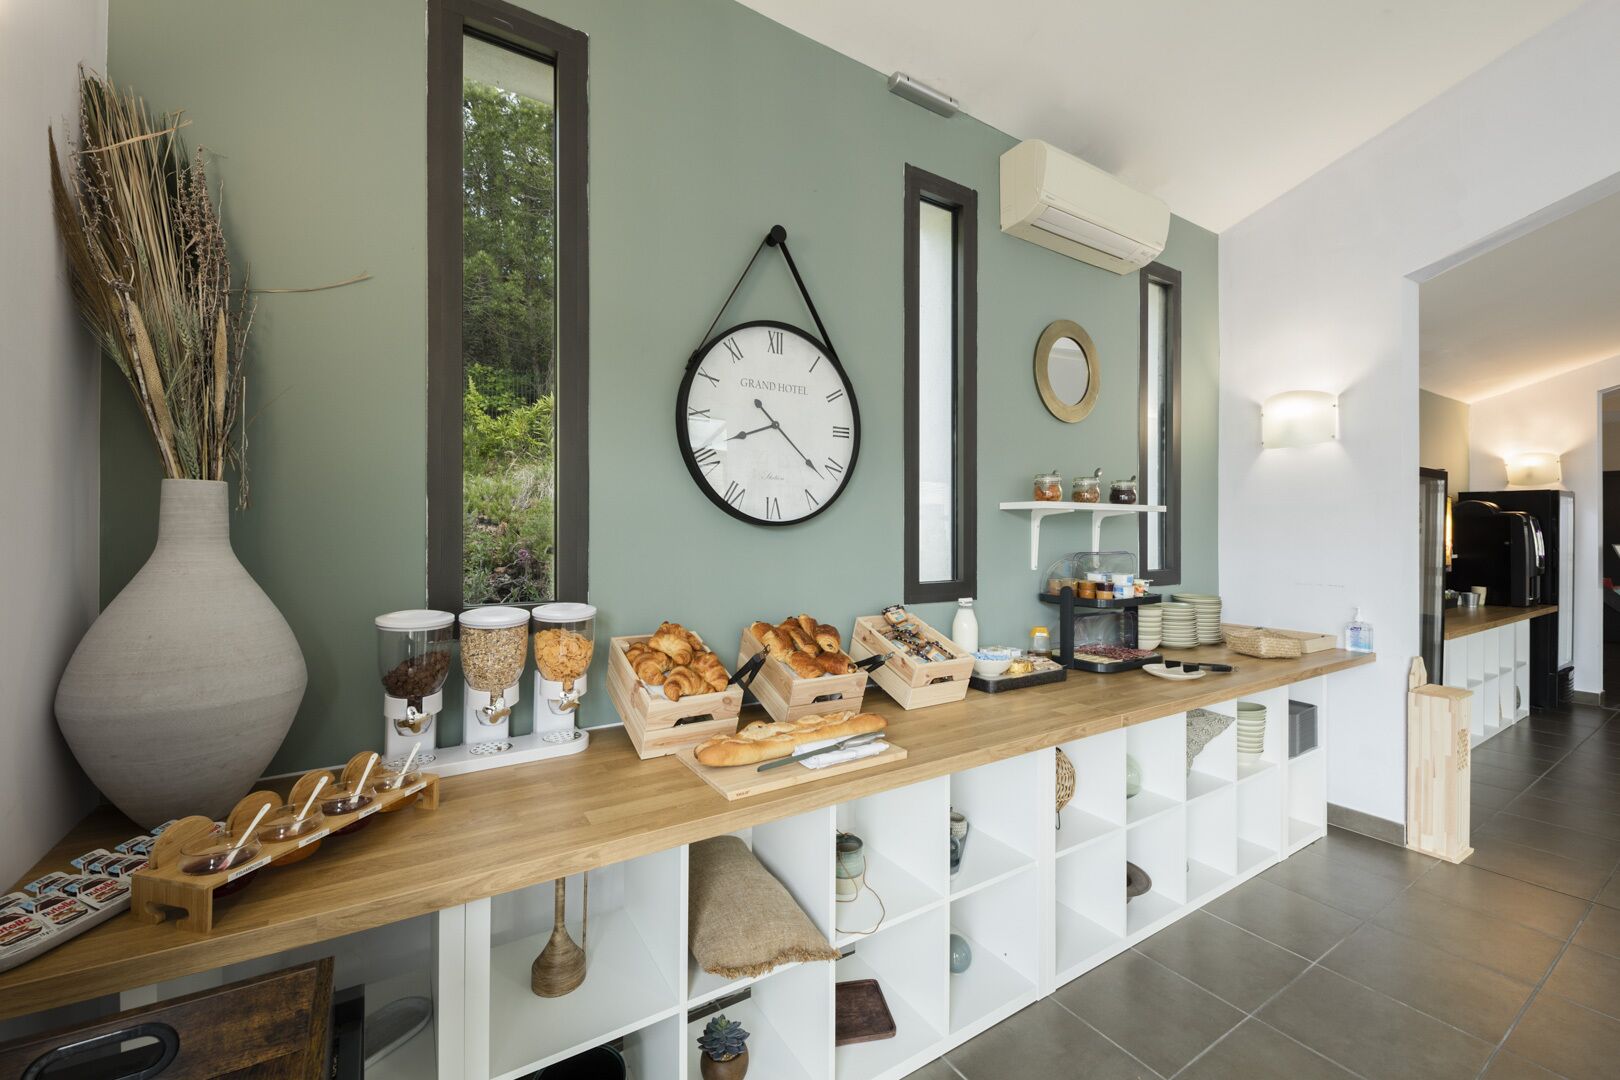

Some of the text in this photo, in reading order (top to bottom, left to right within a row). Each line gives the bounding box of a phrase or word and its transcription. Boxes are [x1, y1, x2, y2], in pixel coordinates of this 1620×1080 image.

[723, 337, 744, 364] XI
[767, 330, 784, 355] XII
[697, 367, 720, 388] X
[739, 377, 808, 396] GRAND HOTEL
[825, 389, 843, 403] II
[832, 426, 850, 439] III
[824, 457, 843, 481] IV
[766, 497, 782, 520] VI
[804, 489, 819, 511] V
[85, 880, 118, 897] nutella
[41, 899, 77, 917] nutella
